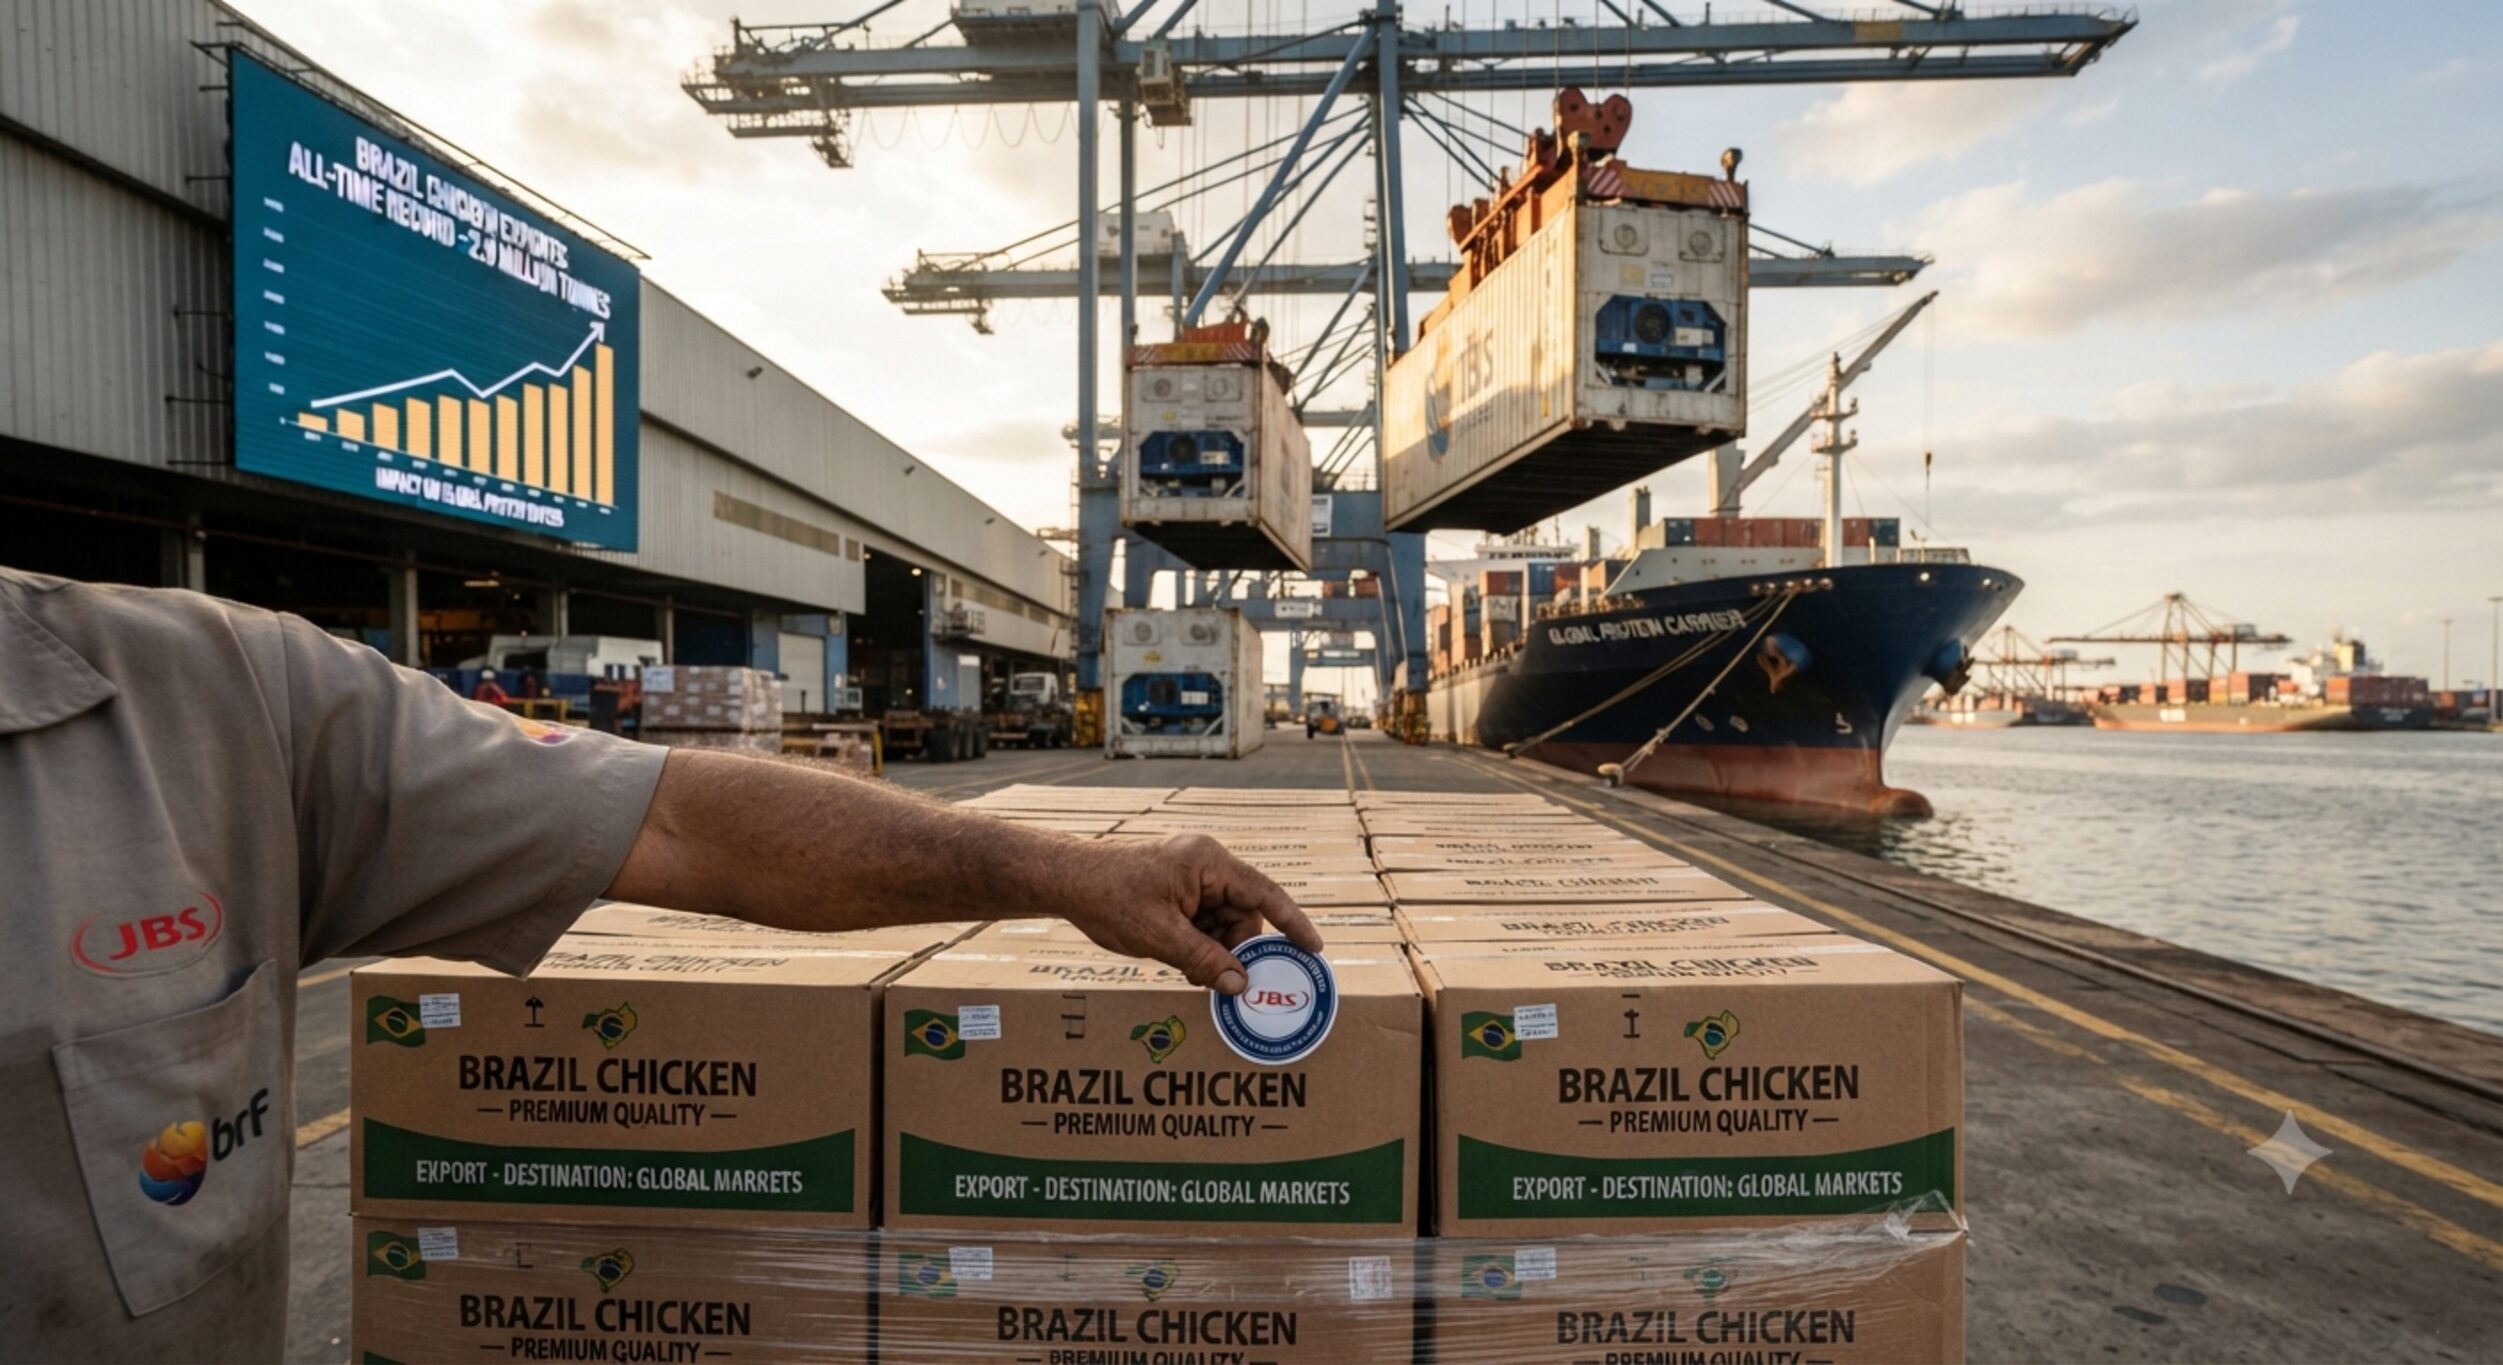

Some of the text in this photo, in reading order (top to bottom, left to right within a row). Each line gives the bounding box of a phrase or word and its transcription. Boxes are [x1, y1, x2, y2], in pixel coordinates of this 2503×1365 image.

[108, 906, 207, 961] JBS
[1251, 990, 1297, 1007] JBS
[459, 1054, 758, 1097] BRAZIL CHICKEN
[1001, 1068, 1307, 1108] BRAZIL CHICKEN
[1558, 1064, 1860, 1104] BRAZIL CHICKEN
[509, 1099, 706, 1130] PREMIUM QUALITY
[1053, 1112, 1256, 1140] PREMIUM QUALITY
[1609, 1108, 1809, 1136] PREMIUM QUALITY
[416, 1160, 488, 1185] EXPORT
[503, 1163, 633, 1190] DESTINATION:
[636, 1166, 711, 1192] GLOBAL
[955, 1174, 1029, 1200] EXPORT
[1044, 1176, 1178, 1204] DESTINATION:
[1180, 1179, 1256, 1205] GLOBAL
[1258, 1180, 1351, 1206] MARKETS
[1512, 1175, 1587, 1201] EXPORT
[1602, 1174, 1734, 1200] DESTINATION:
[1737, 1172, 1811, 1198] GLOBAL
[1813, 1170, 1904, 1197] MARKETS
[460, 1294, 752, 1336] BRAZIL CHICKEN
[997, 1305, 1298, 1347] BRAZIL CHICKEN
[1556, 1309, 1856, 1345] BRAZIL CHICKEN
[511, 1336, 608, 1361] PREMIUM
